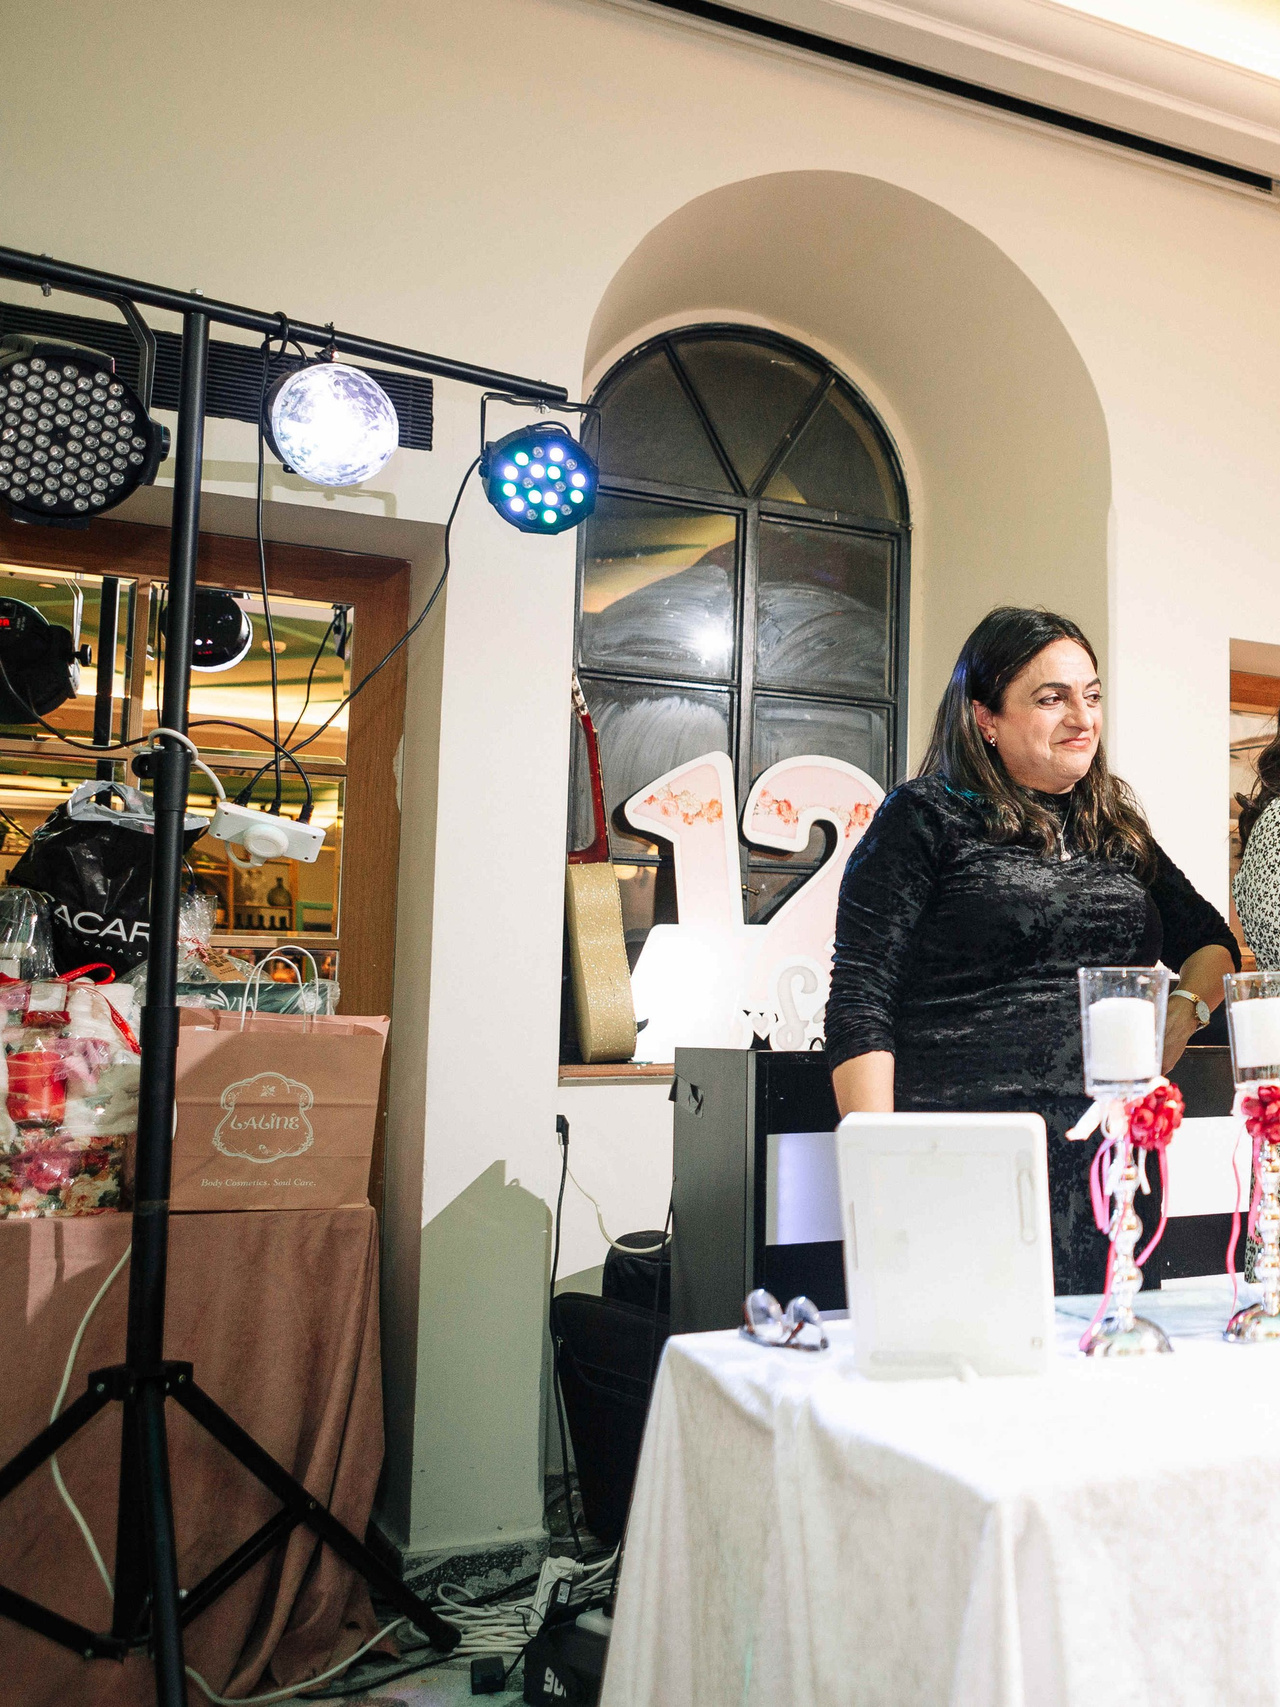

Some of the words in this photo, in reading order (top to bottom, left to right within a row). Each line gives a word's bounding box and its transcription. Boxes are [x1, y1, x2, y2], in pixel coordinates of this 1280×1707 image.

[201, 1178, 222, 1188] Body
[273, 1178, 291, 1187] Soul
[293, 1178, 317, 1187] Care.
